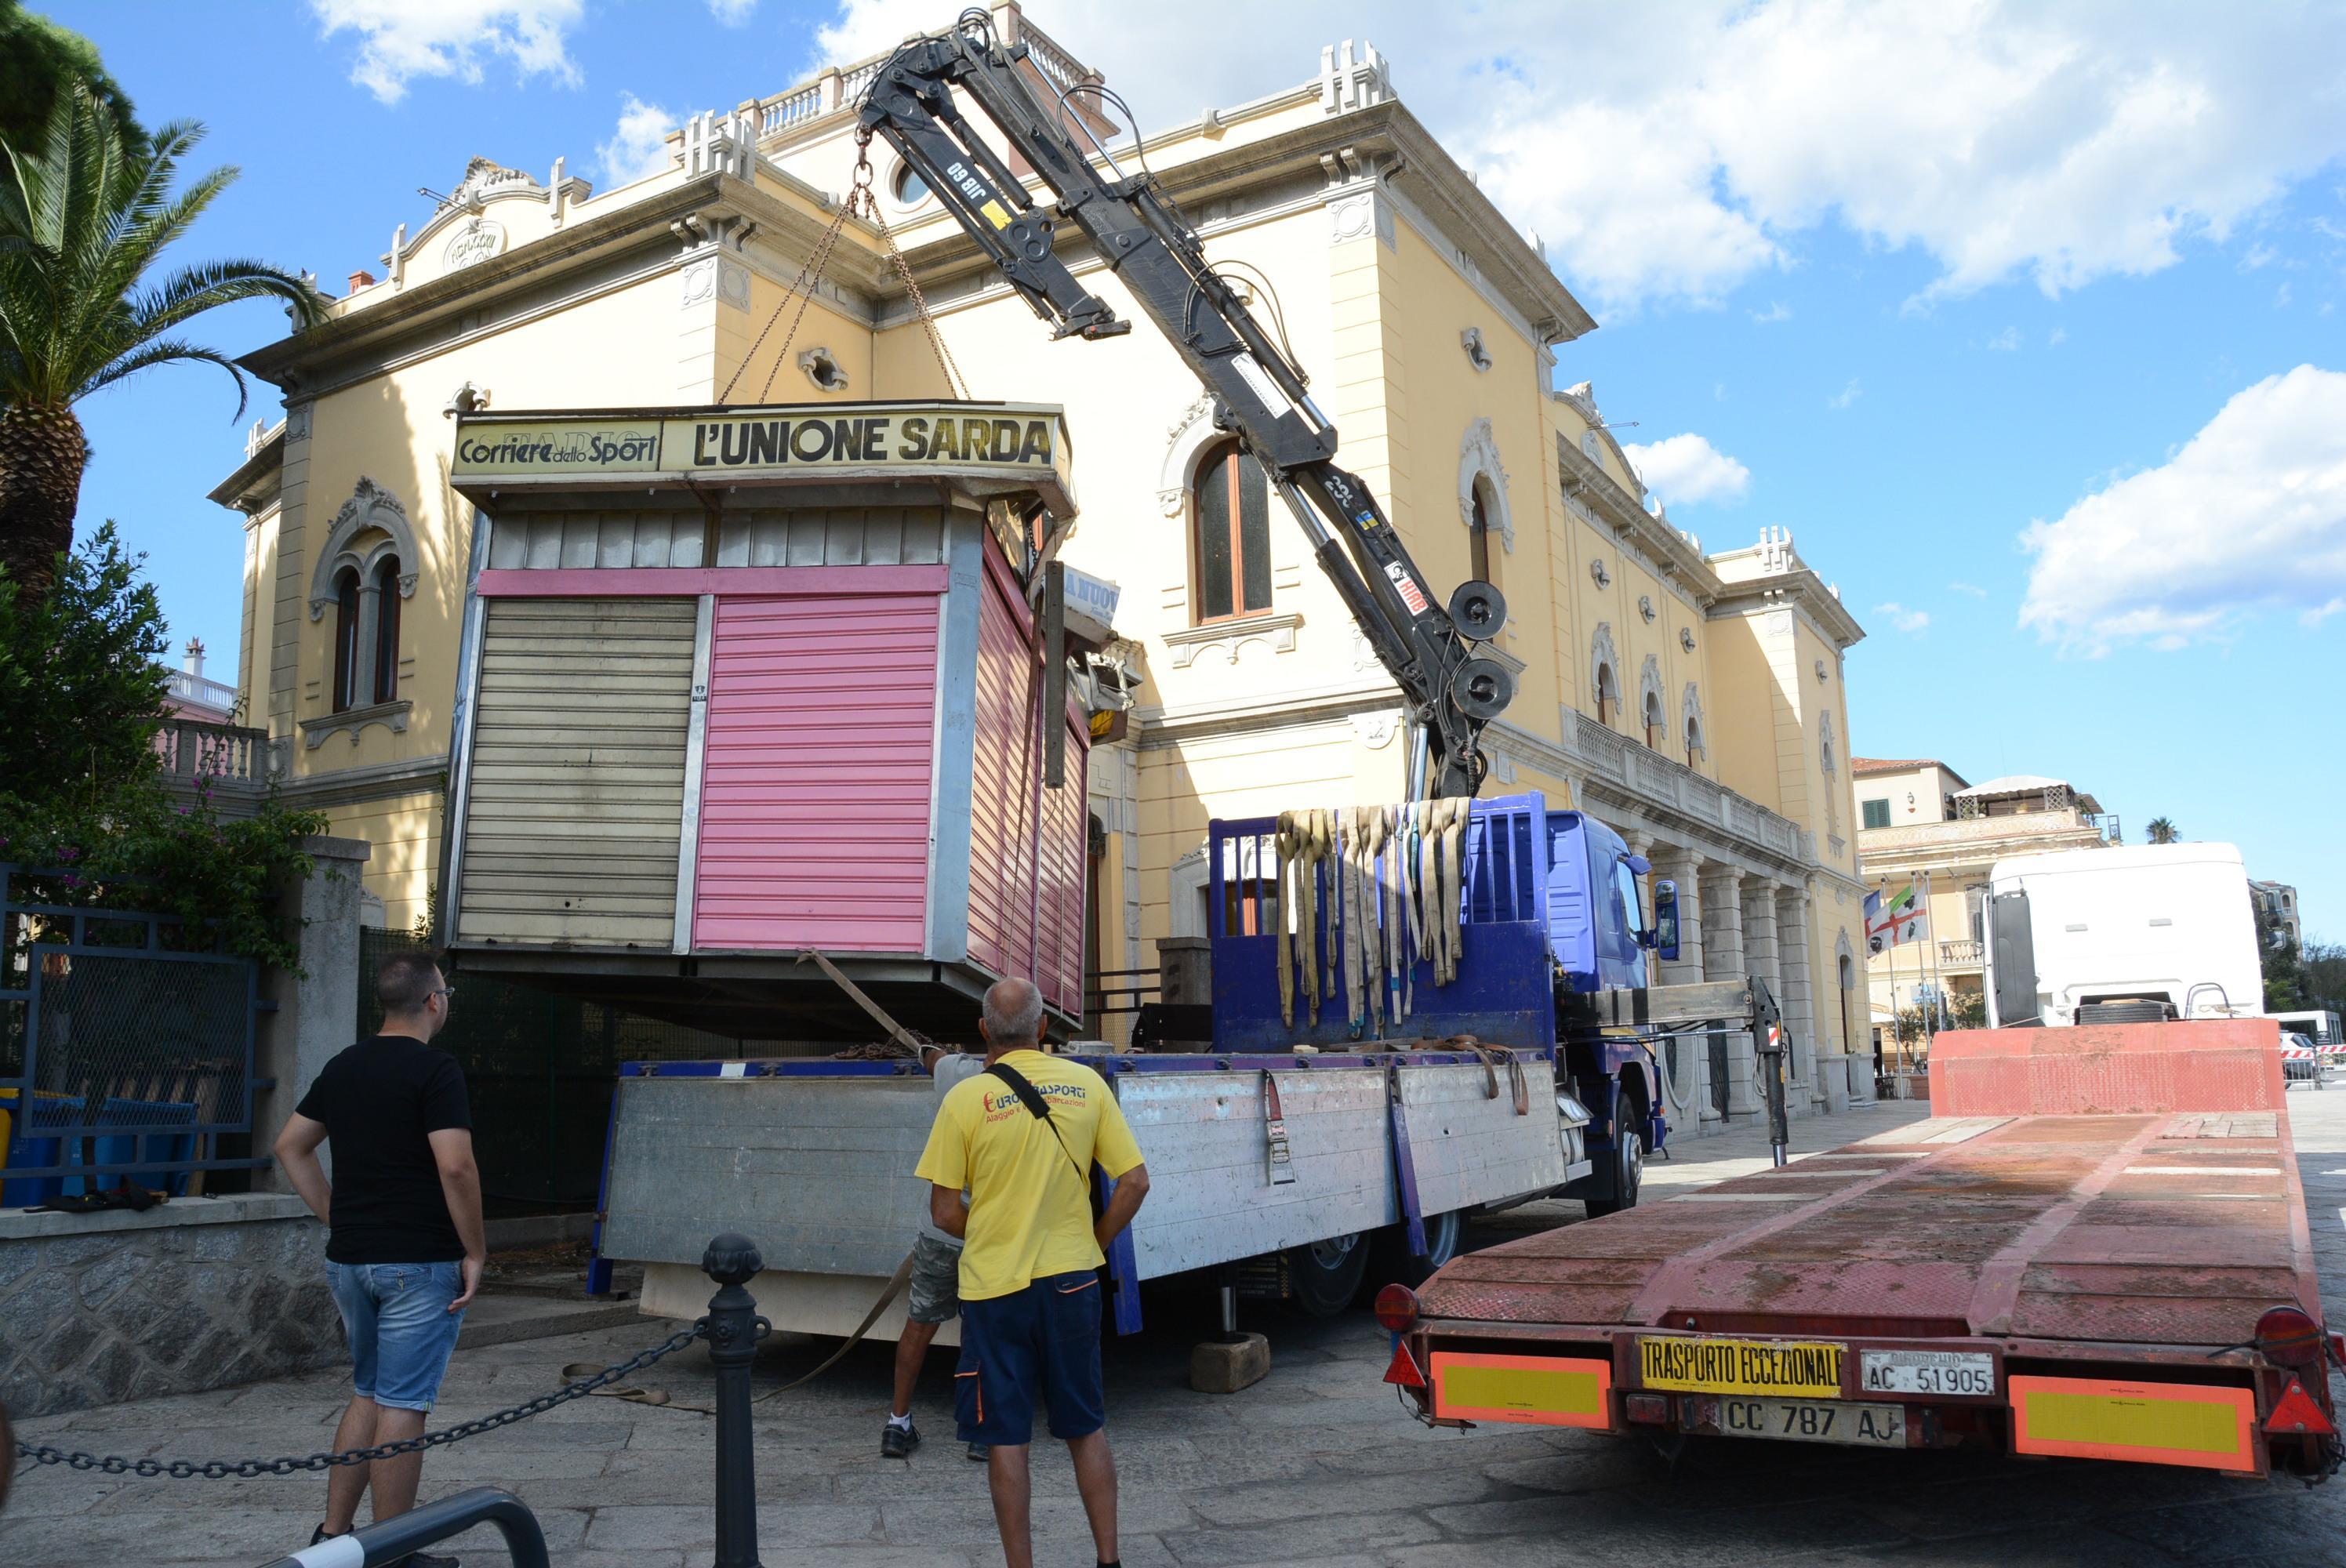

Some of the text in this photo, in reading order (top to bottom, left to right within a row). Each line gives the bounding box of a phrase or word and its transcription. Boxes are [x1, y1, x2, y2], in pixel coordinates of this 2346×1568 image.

[946, 162, 986, 200] JIB 60
[459, 435, 657, 465] Corriere dello Sport
[693, 417, 1052, 466] L'UNIONE SARDA
[1398, 579, 1429, 612] HIAB
[986, 1109, 1015, 1123] Alaggio
[1643, 1341, 1736, 1383] TRASPORTO
[1870, 1367, 1988, 1392] AC 51905
[1727, 1401, 1894, 1440] CC 787 AJ
